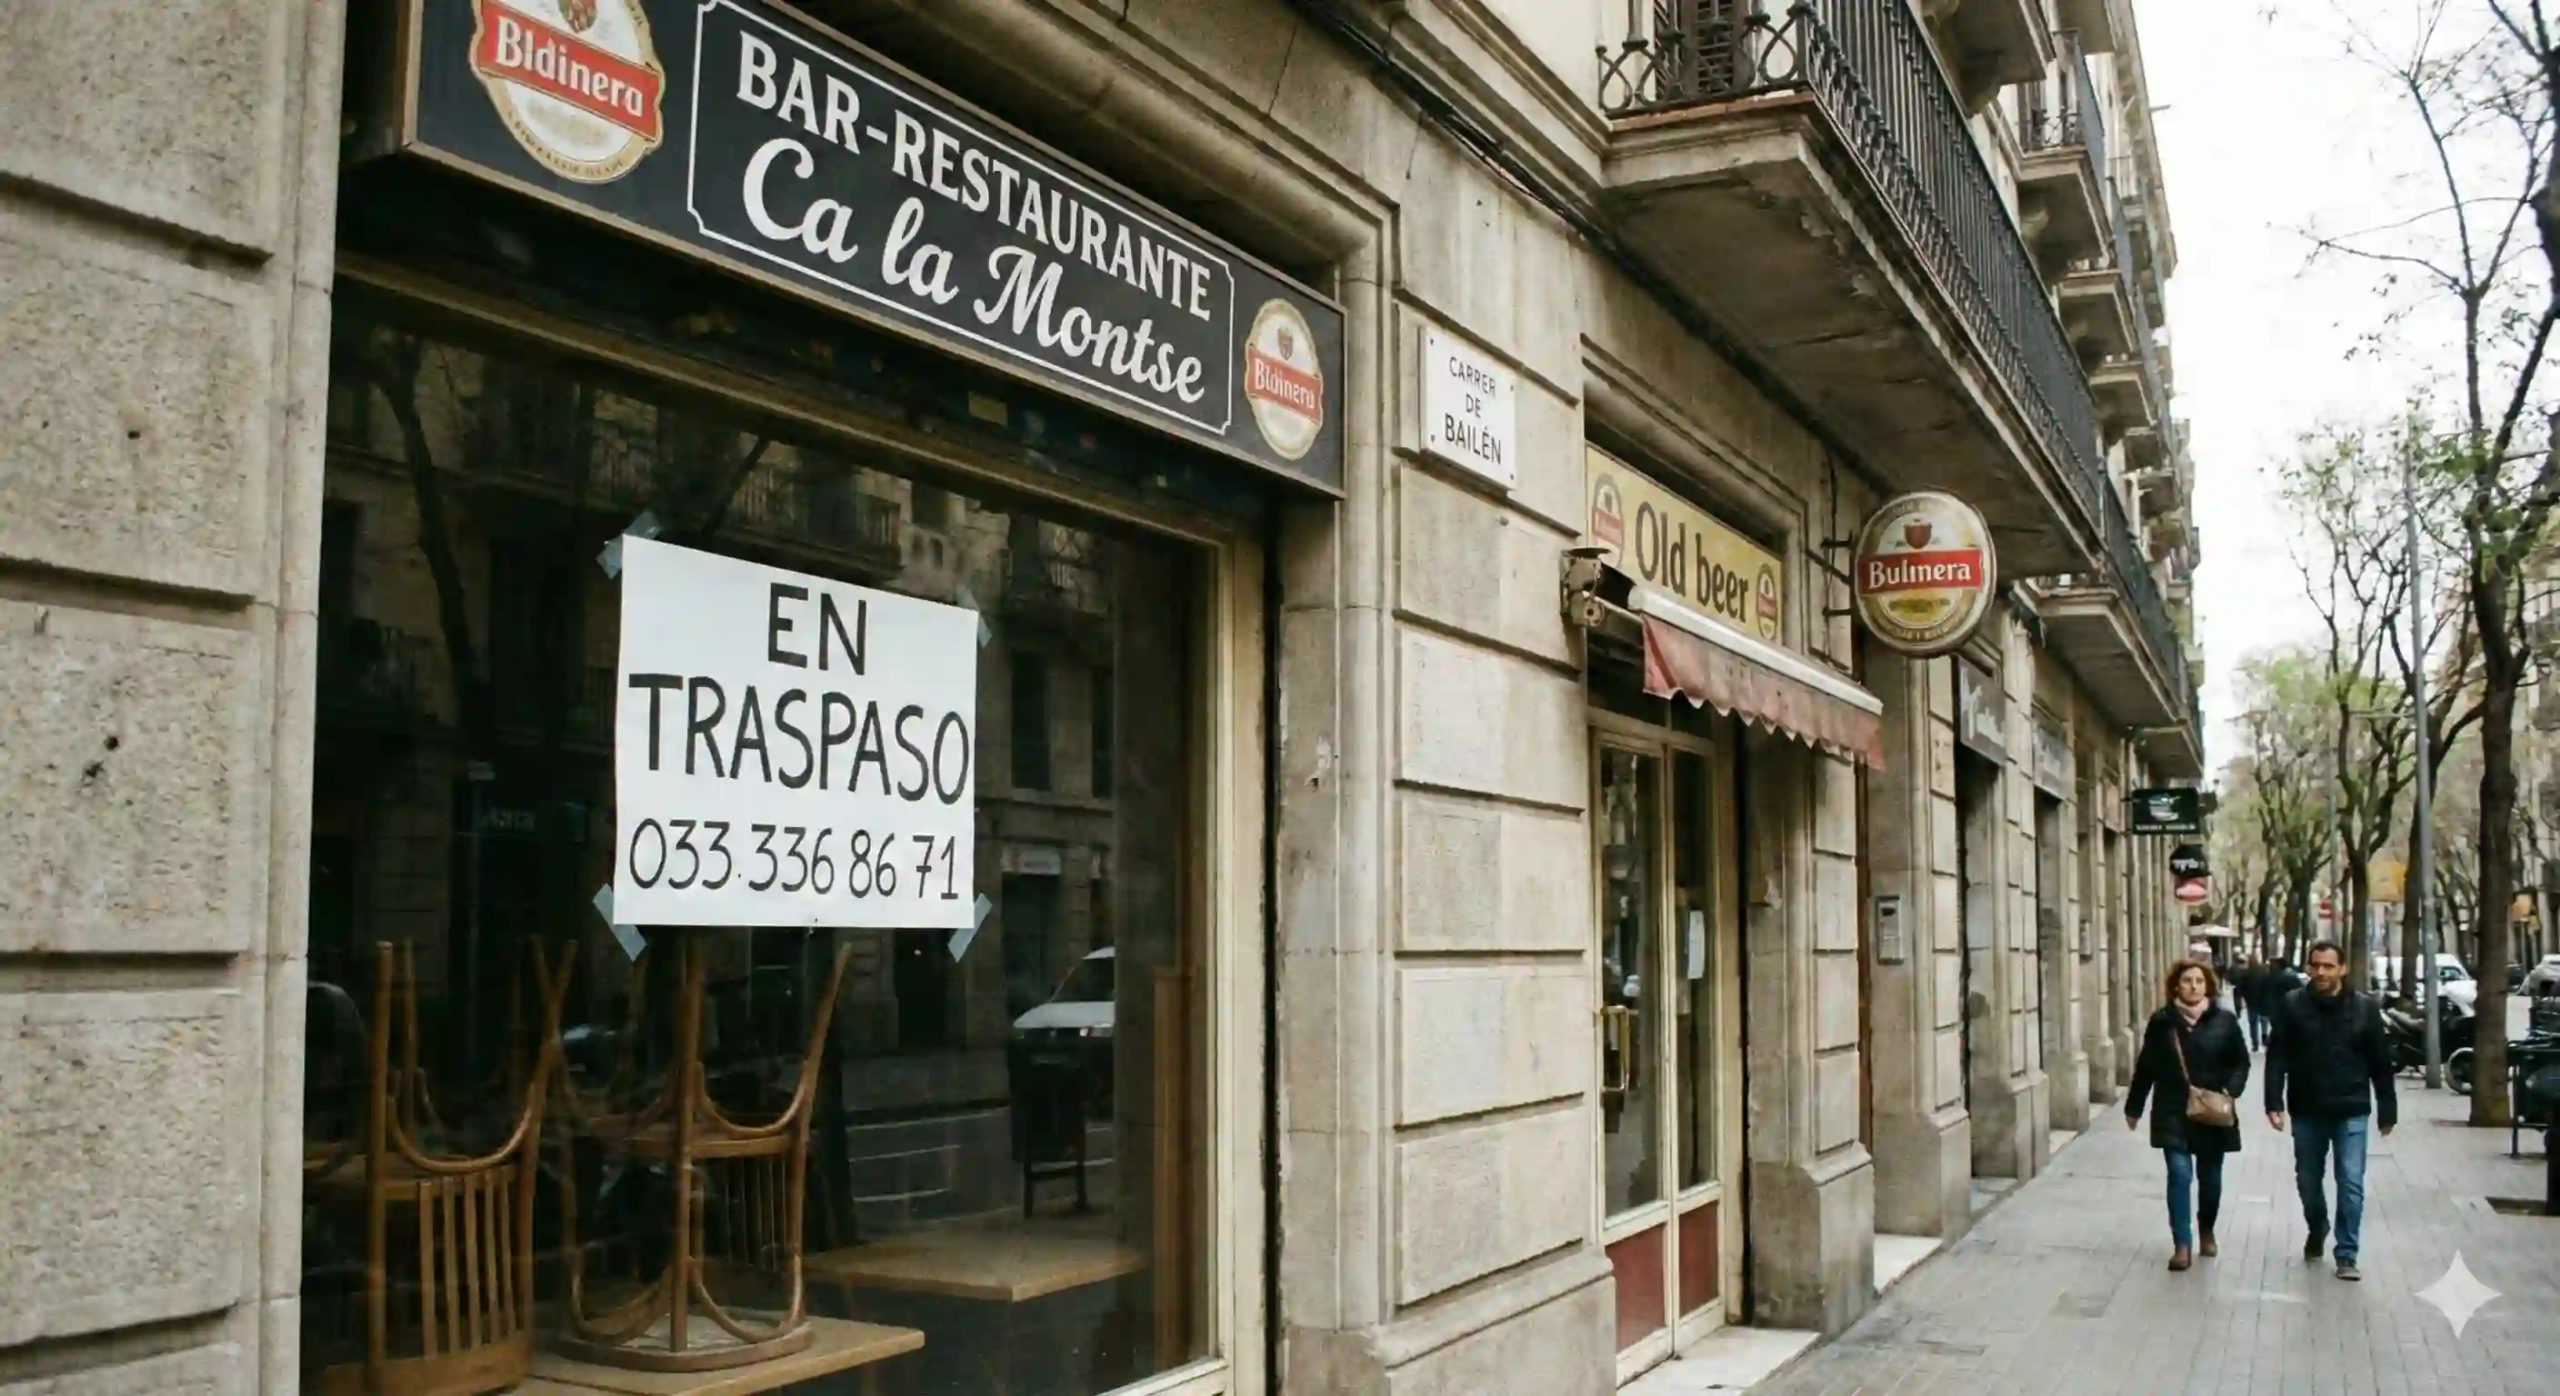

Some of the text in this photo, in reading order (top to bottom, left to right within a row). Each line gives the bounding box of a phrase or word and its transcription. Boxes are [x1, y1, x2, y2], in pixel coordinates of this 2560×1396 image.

[736, 30, 1212, 321] BAR-RESTAURANTE
[742, 137, 859, 264] Ca
[882, 196, 960, 305] la
[973, 245, 1205, 404] Montse
[1449, 356, 1496, 396] CARRER
[1465, 393, 1481, 418] DE
[1444, 412, 1501, 465] BAILÉN
[1635, 501, 1749, 623] Old beer
[768, 582, 867, 676] EN
[628, 673, 970, 805] TRASPASO
[848, 829, 897, 898] 86
[911, 835, 959, 900] 71
